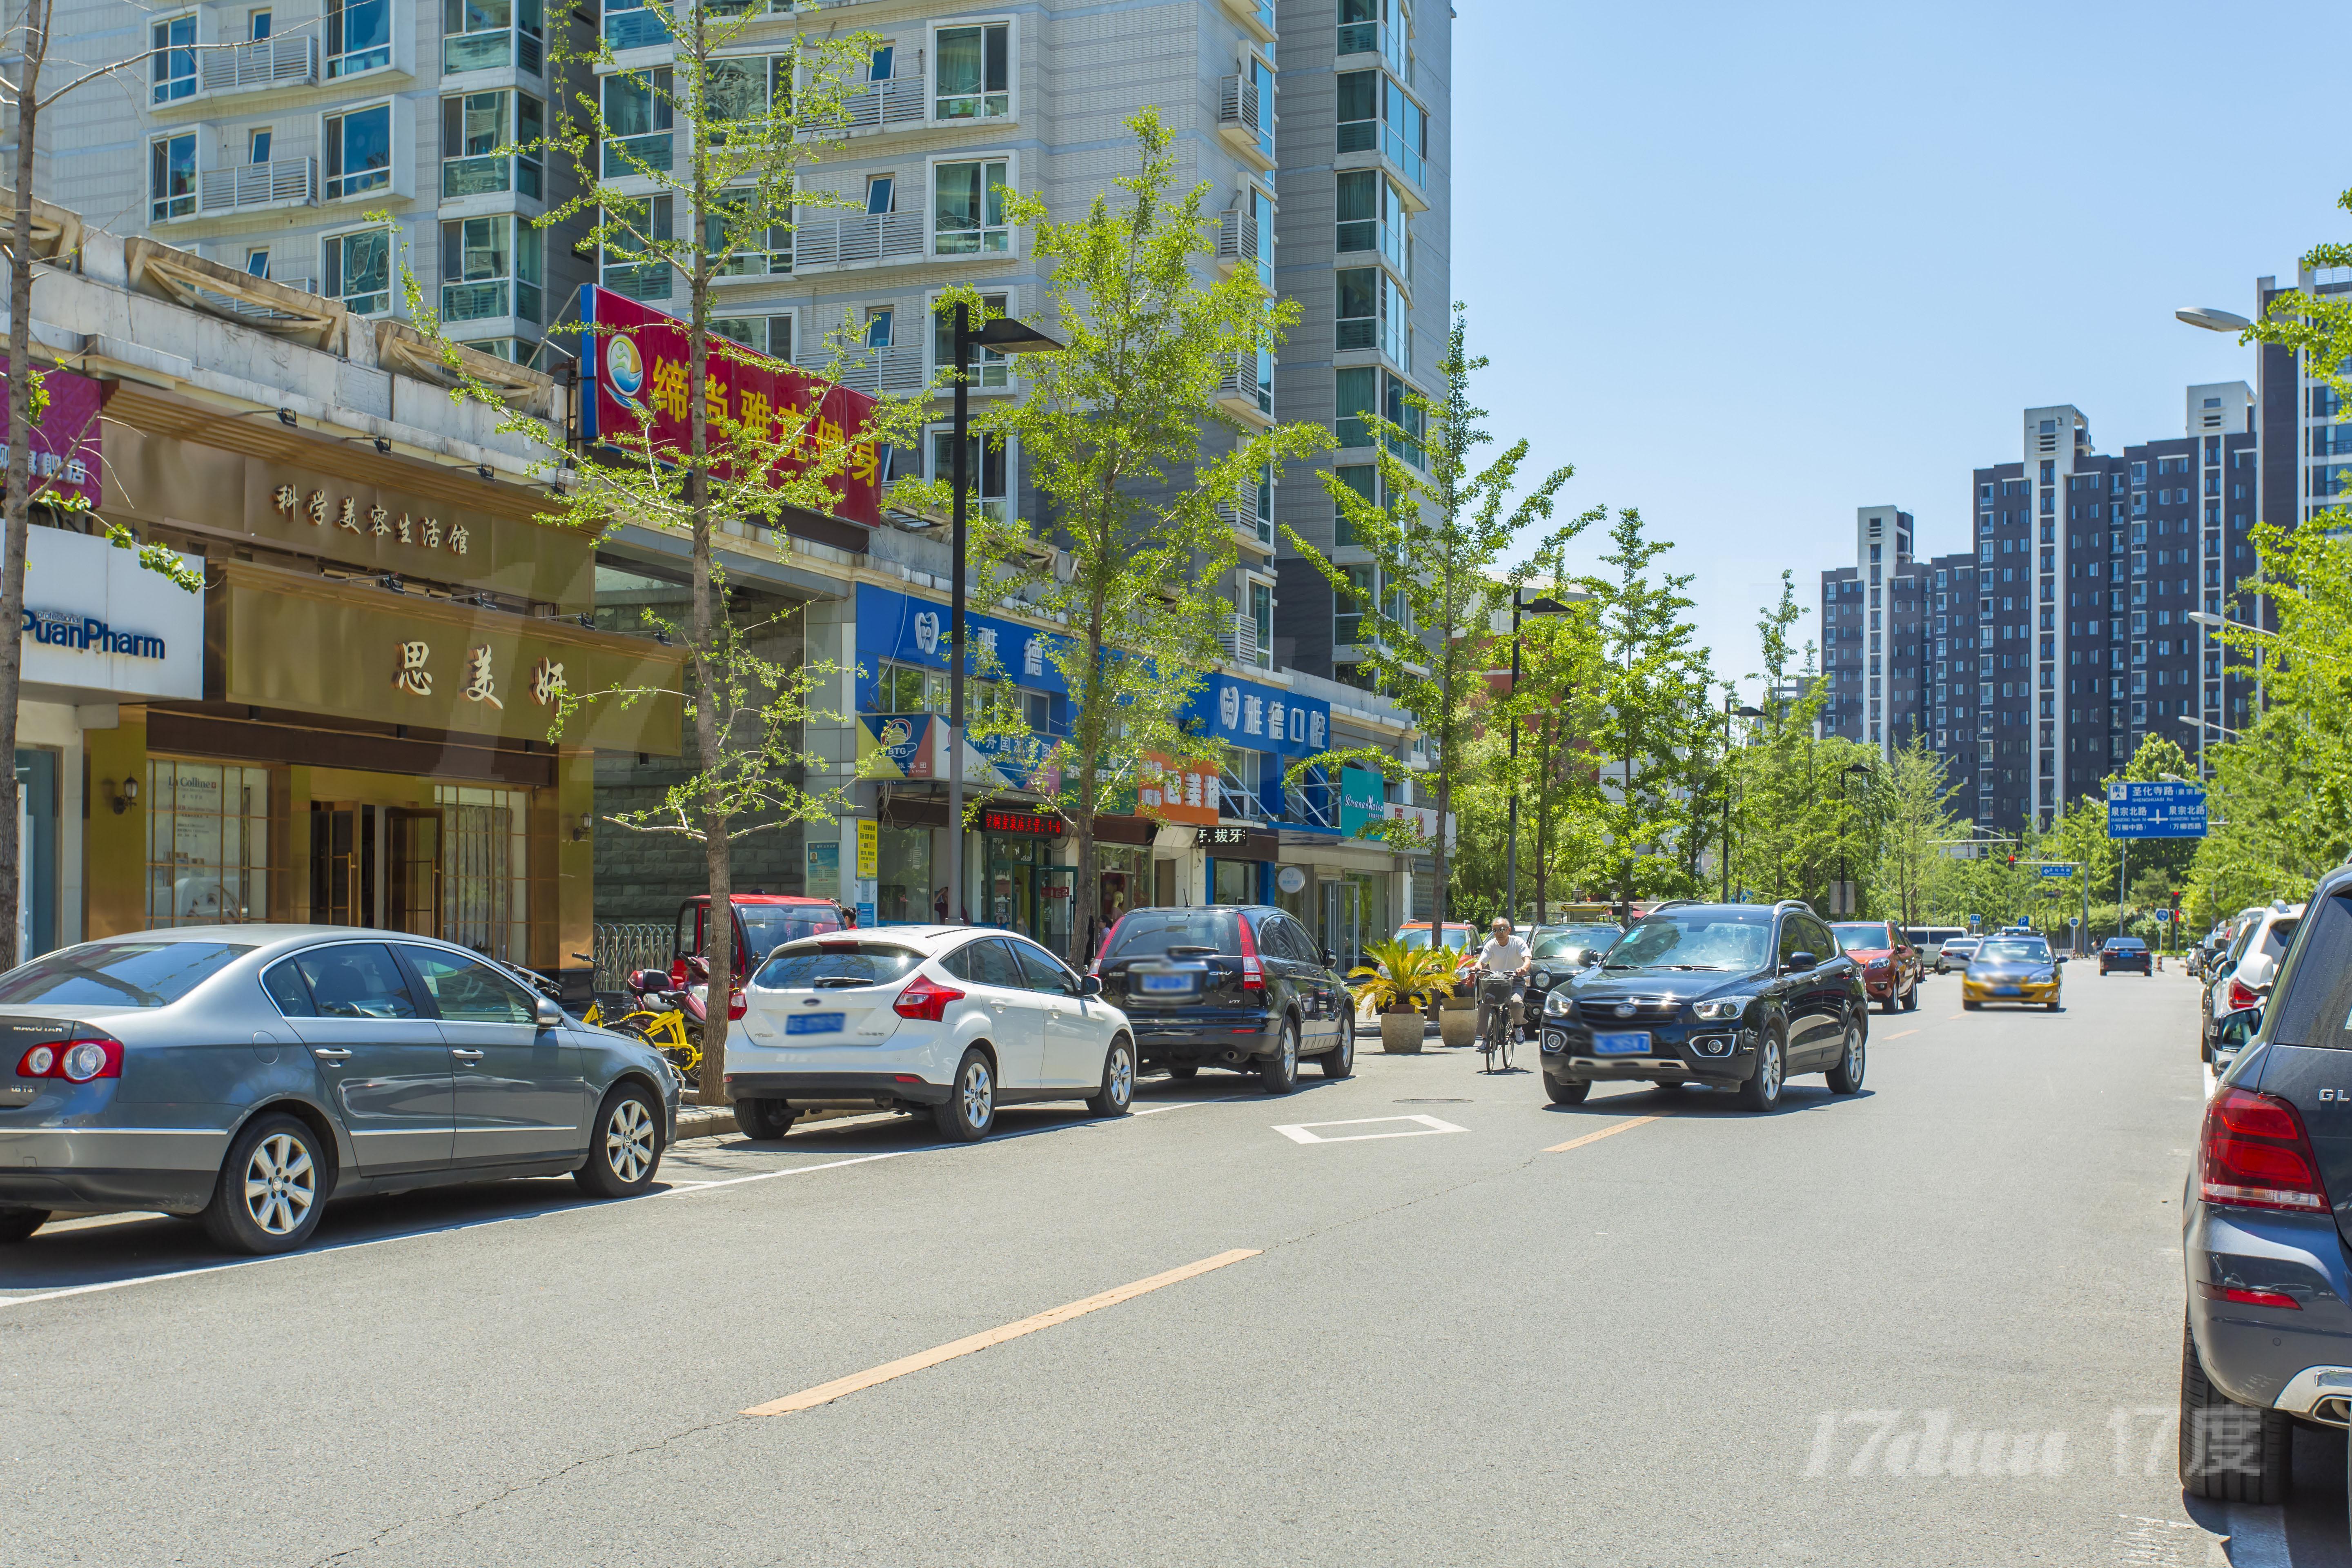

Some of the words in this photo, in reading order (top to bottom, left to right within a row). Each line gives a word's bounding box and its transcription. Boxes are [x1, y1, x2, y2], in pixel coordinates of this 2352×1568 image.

[275, 483, 470, 556] 科学美容生活馆
[37, 612, 80, 624] professional
[18, 609, 165, 660] PuanPharm
[399, 641, 567, 712] 思美妍
[1243, 694, 1326, 749] 雅德口腔
[180, 777, 211, 788] Colline
[2132, 786, 2174, 796] 圣化寺路
[2111, 806, 2147, 816] 泉宗北路
[2169, 805, 2205, 815] 泉宗北路
[2021, 917, 2026, 925] P
